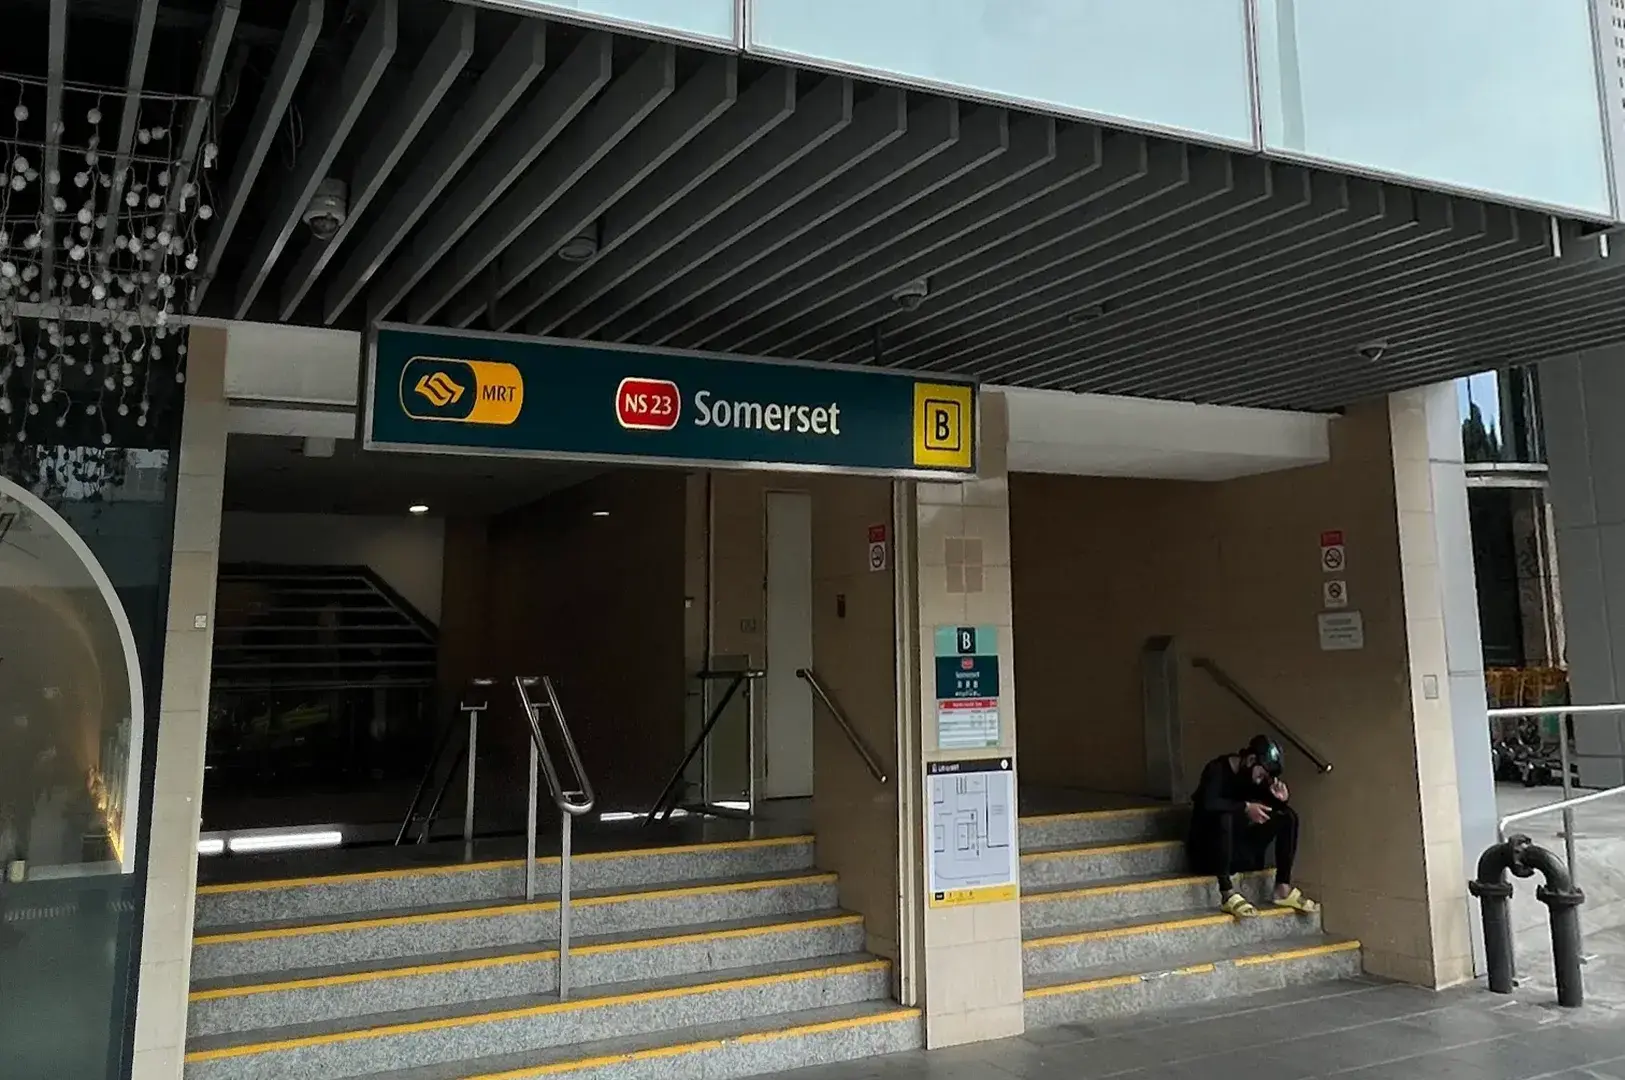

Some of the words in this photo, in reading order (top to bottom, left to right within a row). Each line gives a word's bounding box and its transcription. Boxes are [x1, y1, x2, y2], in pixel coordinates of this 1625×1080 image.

[482, 385, 516, 402] MRT
[625, 393, 648, 414] NS
[650, 395, 672, 415] 23
[694, 390, 840, 435] Somerset
[935, 409, 950, 441] B
[962, 631, 971, 650] B
